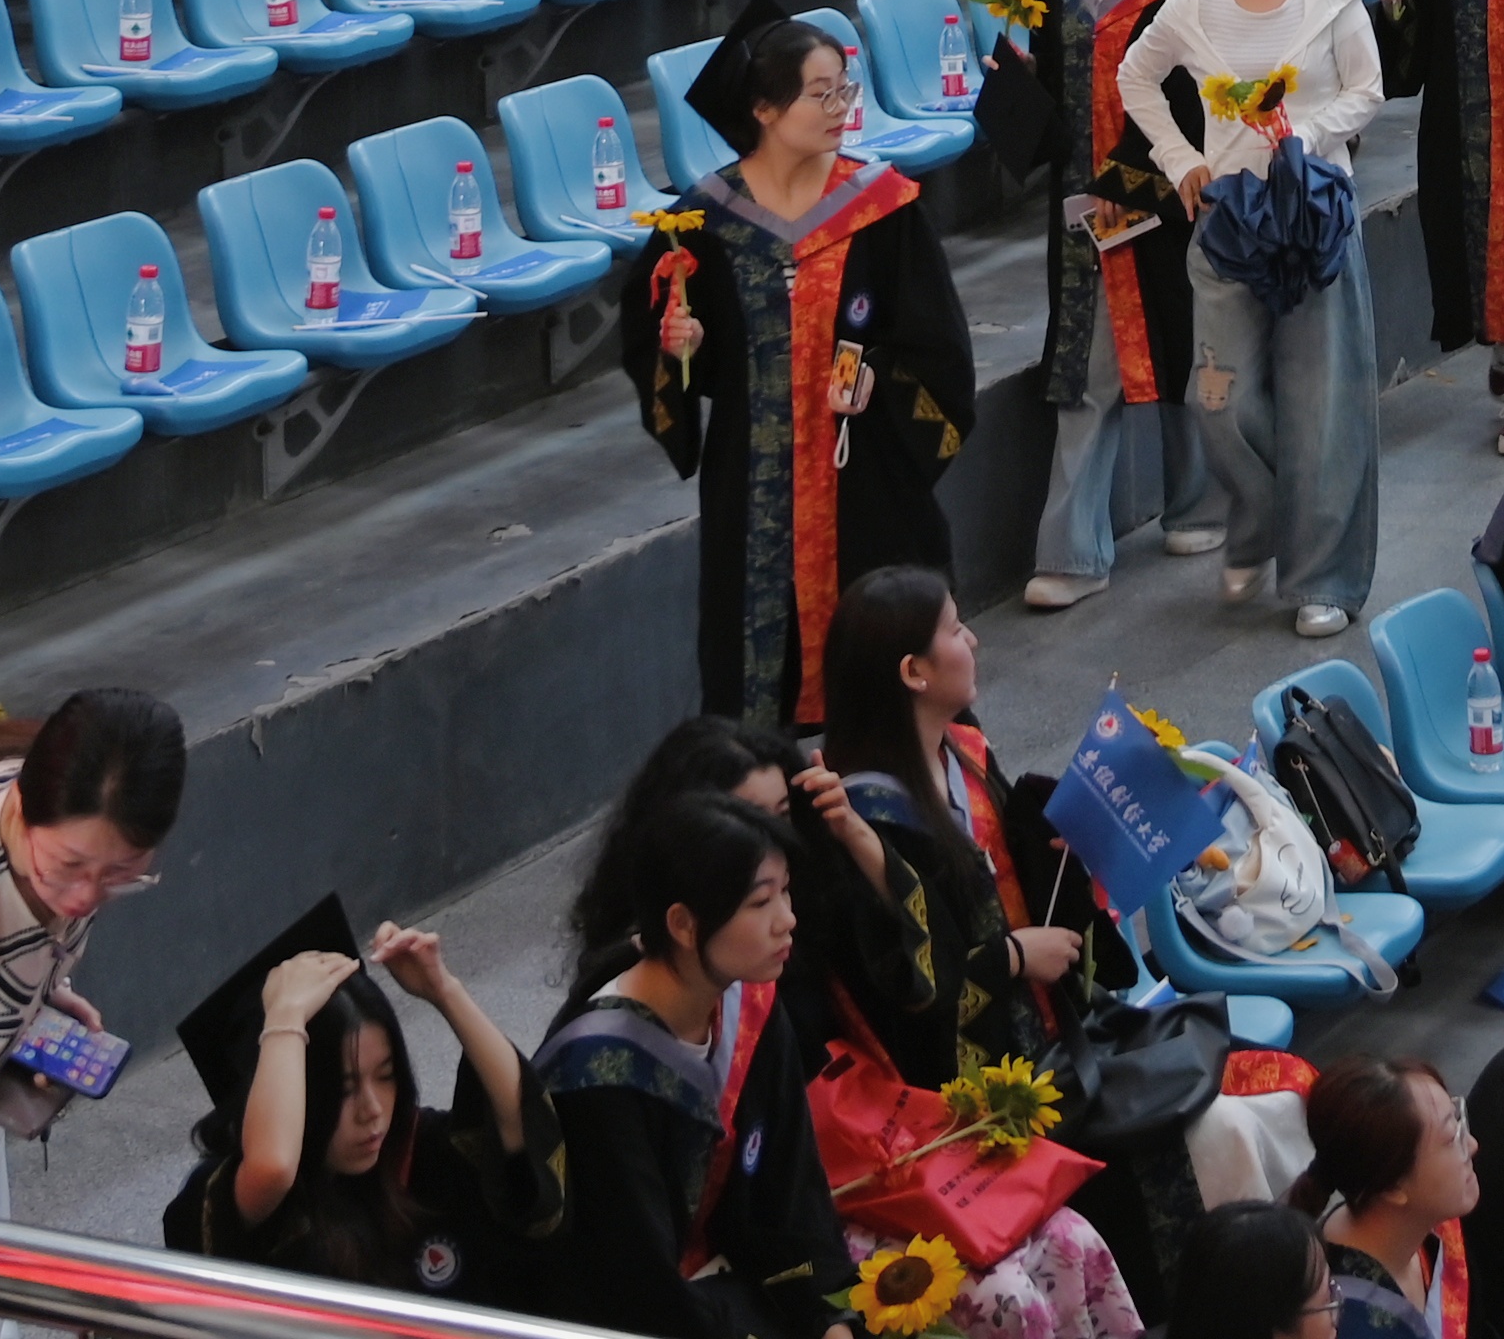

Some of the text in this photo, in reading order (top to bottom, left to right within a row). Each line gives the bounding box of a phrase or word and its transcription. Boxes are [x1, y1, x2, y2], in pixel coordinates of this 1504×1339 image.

[1076, 747, 1172, 856] 安徽财经大学
